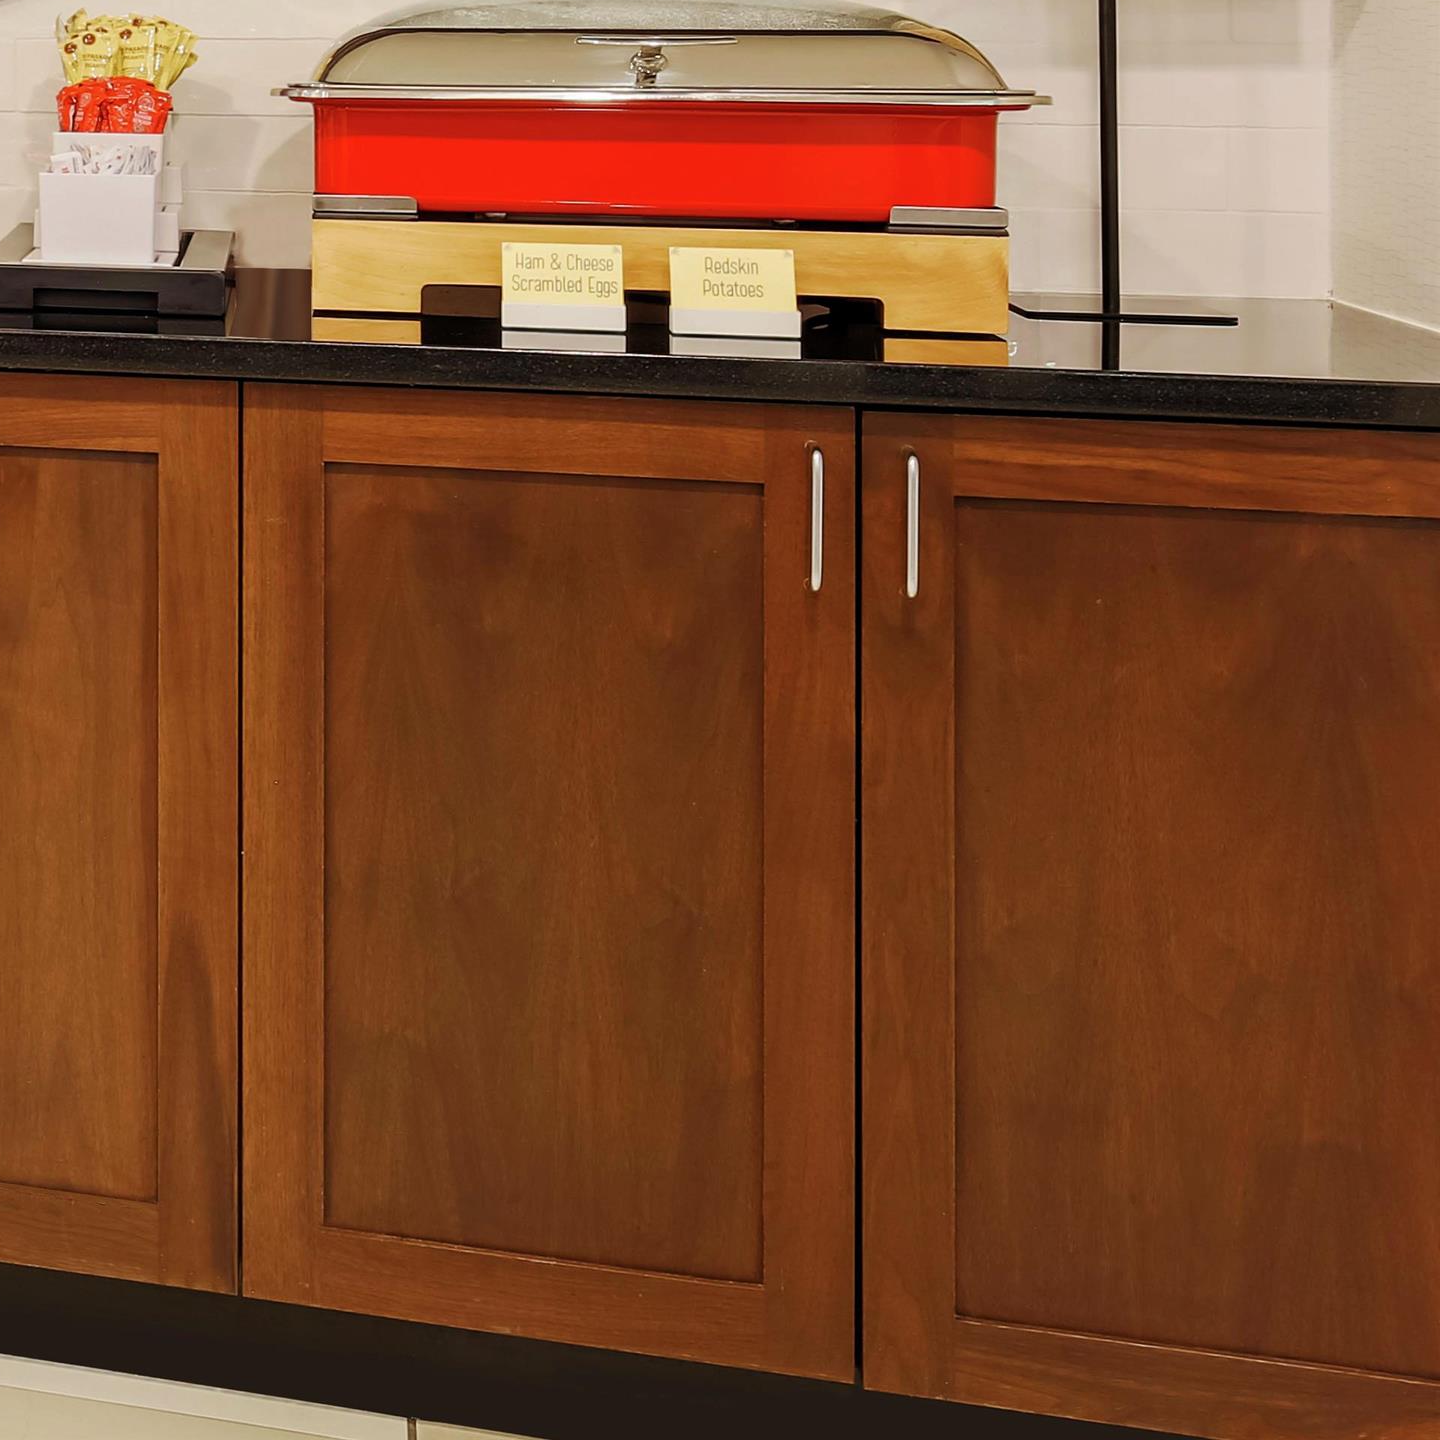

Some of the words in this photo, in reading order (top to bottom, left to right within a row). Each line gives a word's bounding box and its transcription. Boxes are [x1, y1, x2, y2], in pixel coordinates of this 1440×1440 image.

[515, 252, 545, 271] Ham
[550, 252, 562, 270] &
[566, 253, 614, 272] Cheese
[705, 256, 759, 276] Redskin
[511, 275, 583, 293] Scrambled
[588, 277, 618, 298] Eggs
[702, 278, 764, 298] Potatoes
